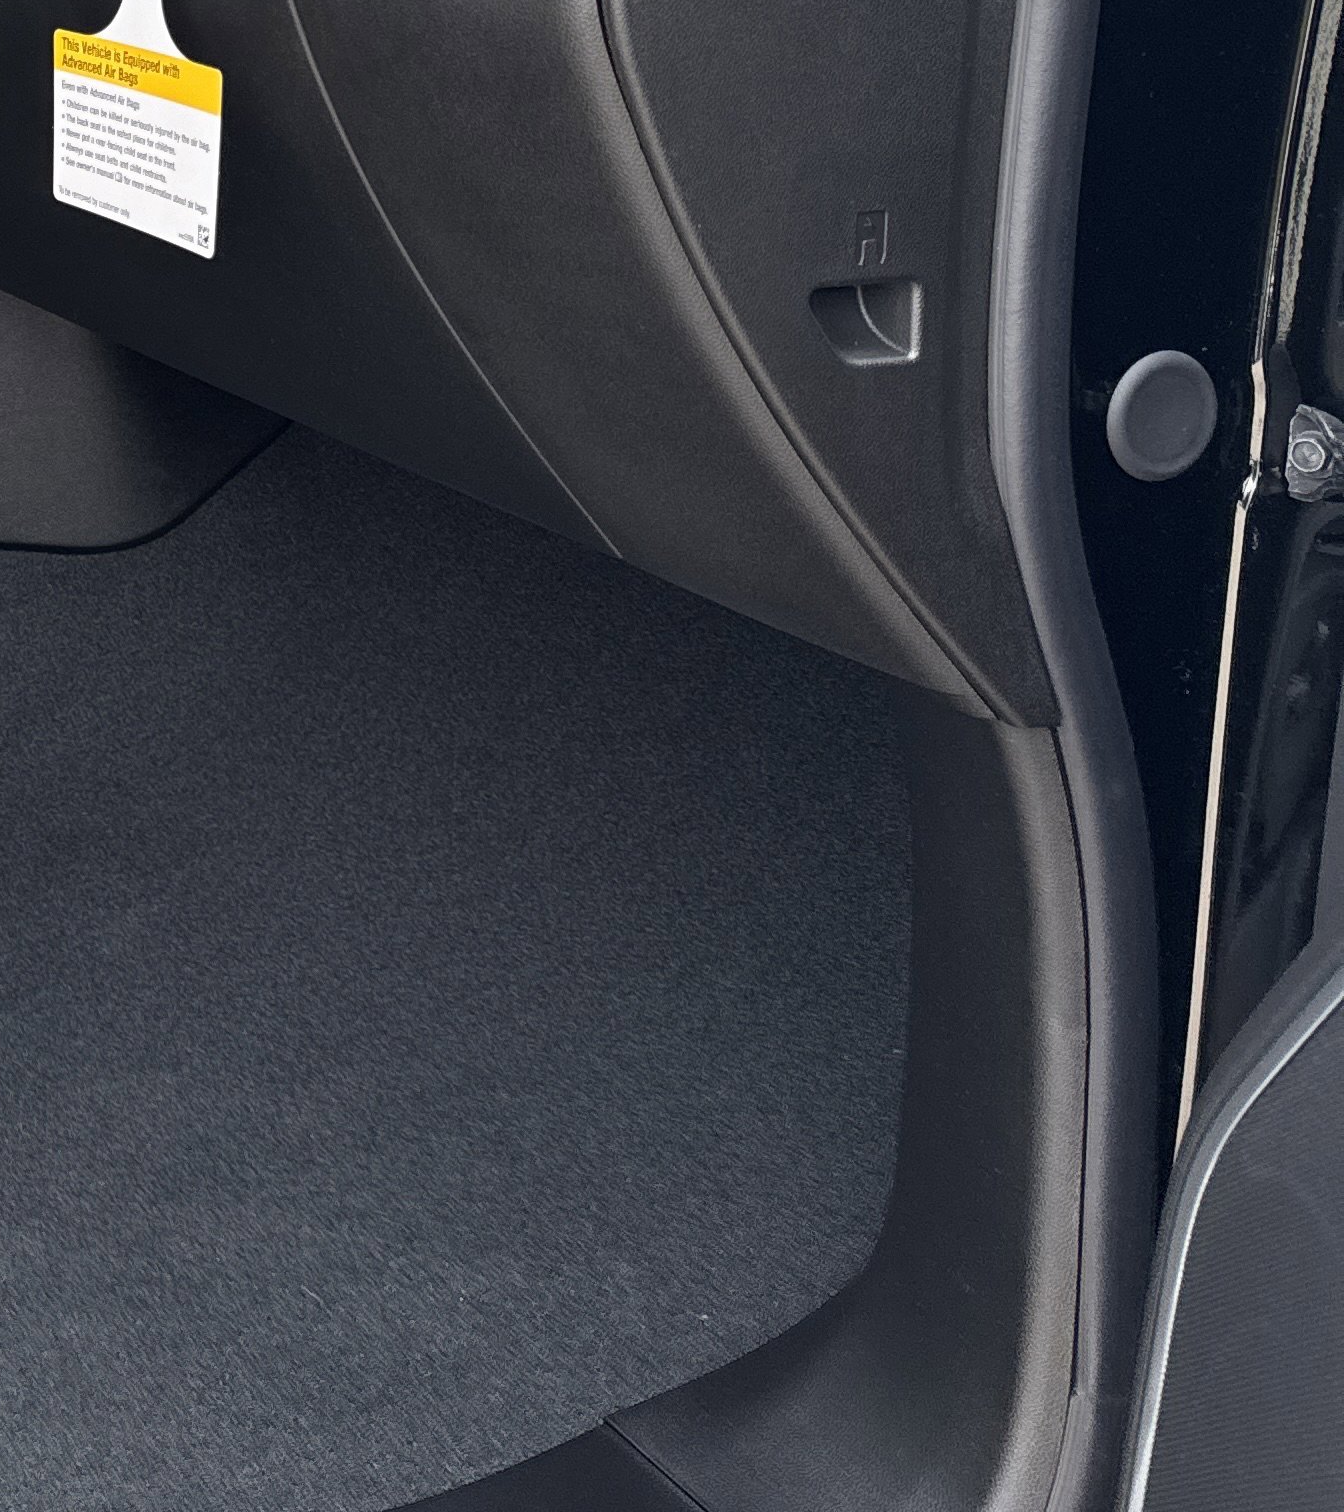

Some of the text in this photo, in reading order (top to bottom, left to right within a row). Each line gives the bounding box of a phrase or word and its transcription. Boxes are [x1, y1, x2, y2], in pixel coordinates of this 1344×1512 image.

[62, 37, 179, 79] This Vehicle is Equipped with
[62, 54, 138, 87] Advanced Air Bags
